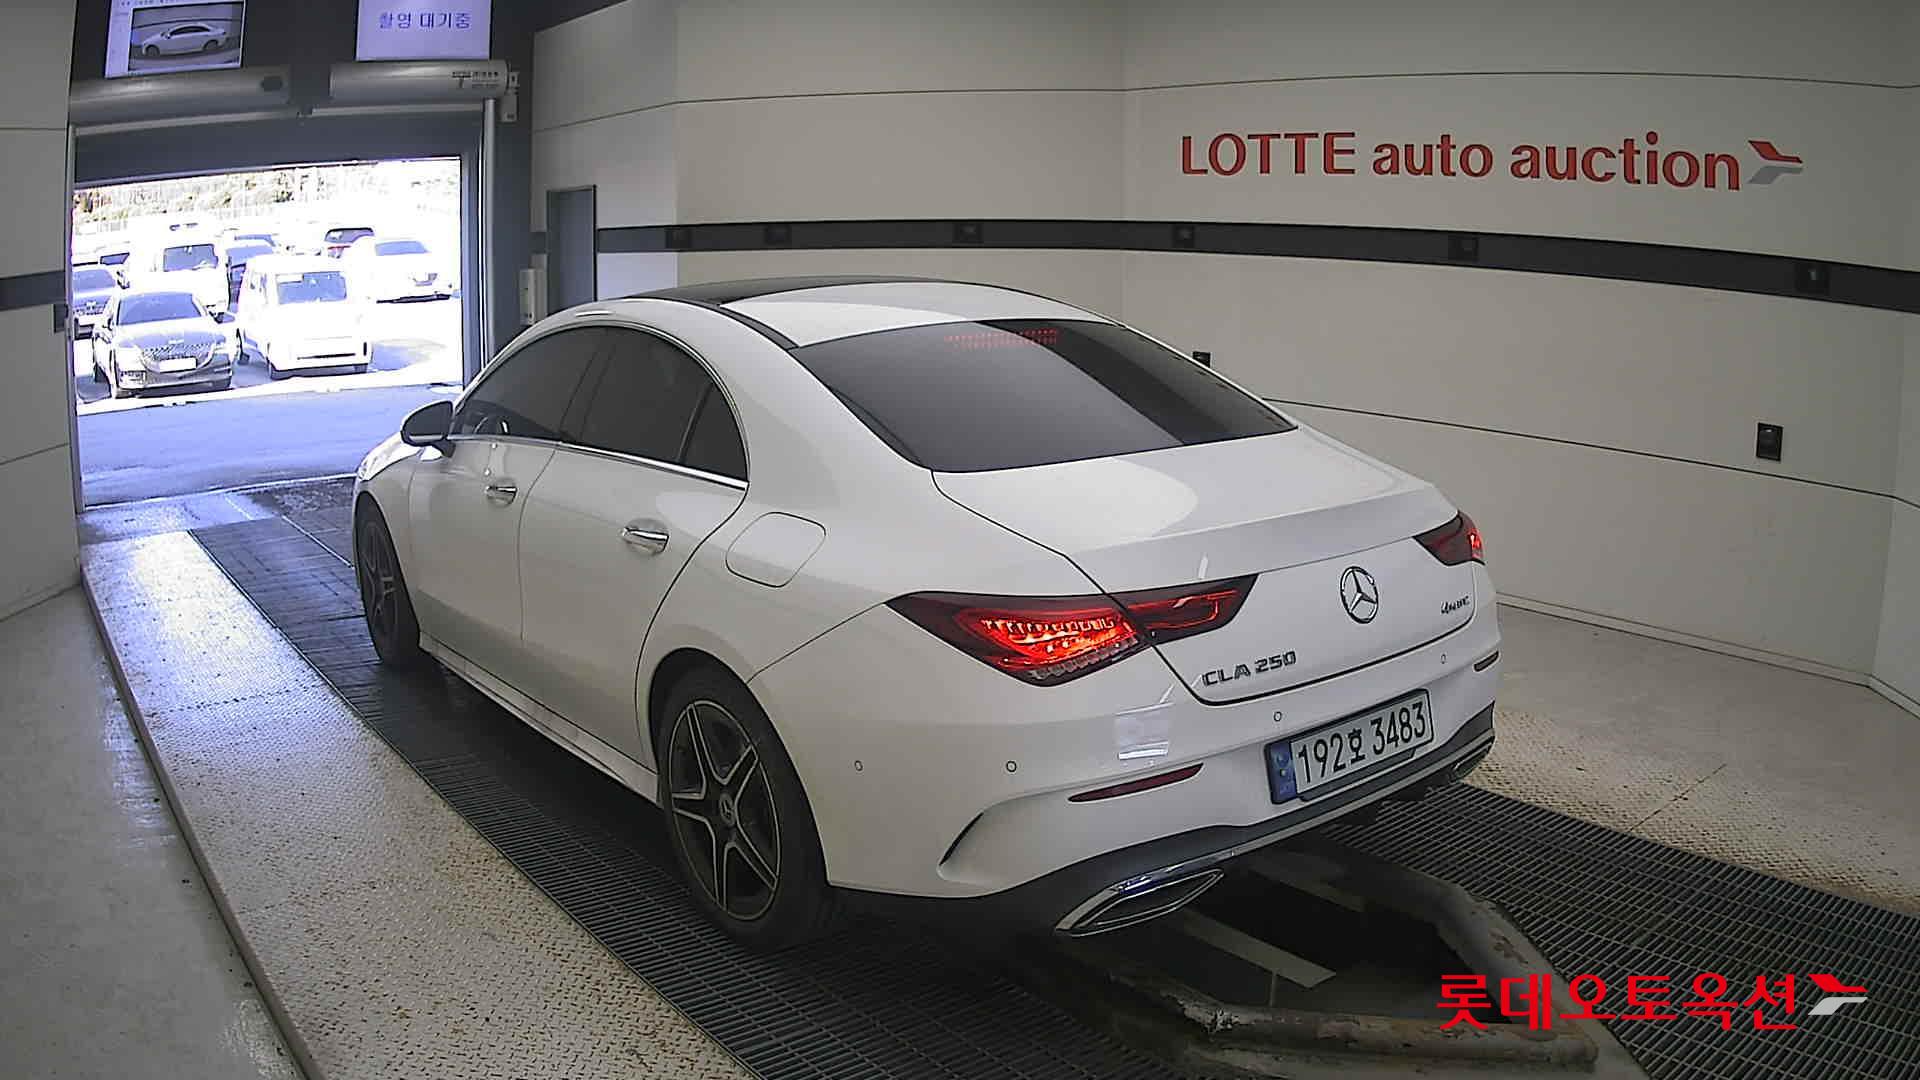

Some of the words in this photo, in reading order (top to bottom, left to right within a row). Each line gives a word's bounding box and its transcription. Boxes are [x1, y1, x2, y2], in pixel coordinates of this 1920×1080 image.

[419, 12, 471, 29] 대기중
[1182, 132, 1355, 176] LOTTE
[1372, 134, 1494, 177] auto
[1510, 131, 1740, 191] auction
[1202, 664, 1251, 686] CLA
[1255, 651, 1297, 674] 250
[1299, 728, 1366, 783] 192호
[1370, 702, 1425, 755] 3483
